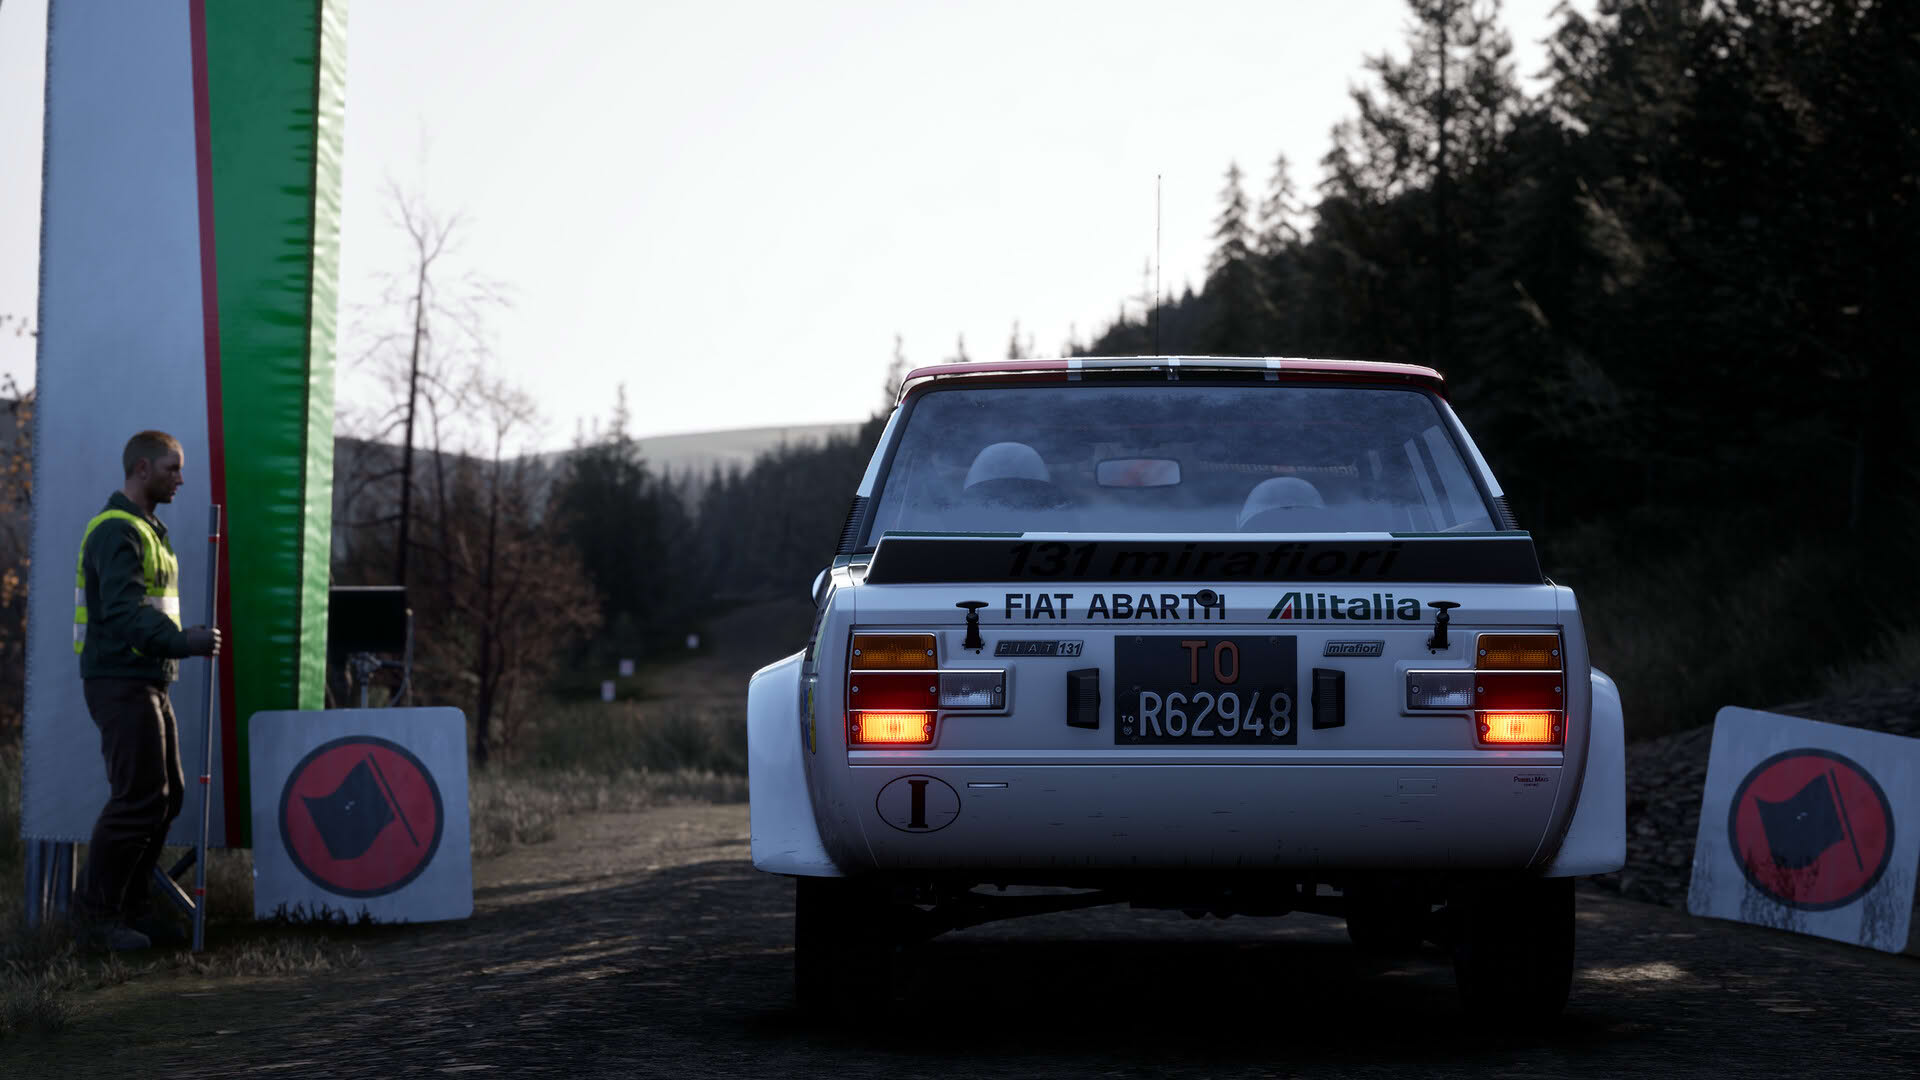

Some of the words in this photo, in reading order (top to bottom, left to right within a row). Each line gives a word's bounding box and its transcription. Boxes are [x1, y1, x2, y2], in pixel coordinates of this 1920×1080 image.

[1008, 543, 1098, 577] 131
[1111, 542, 1403, 577] mirafiori
[1005, 593, 1073, 619] FIAT
[1087, 593, 1225, 619] ABARTH
[1267, 592, 1421, 620] Alitalia
[999, 643, 1054, 653] FIAT
[1059, 643, 1081, 654] 131
[1181, 640, 1239, 684] TO
[1328, 644, 1381, 653] mirafiori
[1139, 691, 1292, 737] R62948
[908, 781, 929, 828] I
